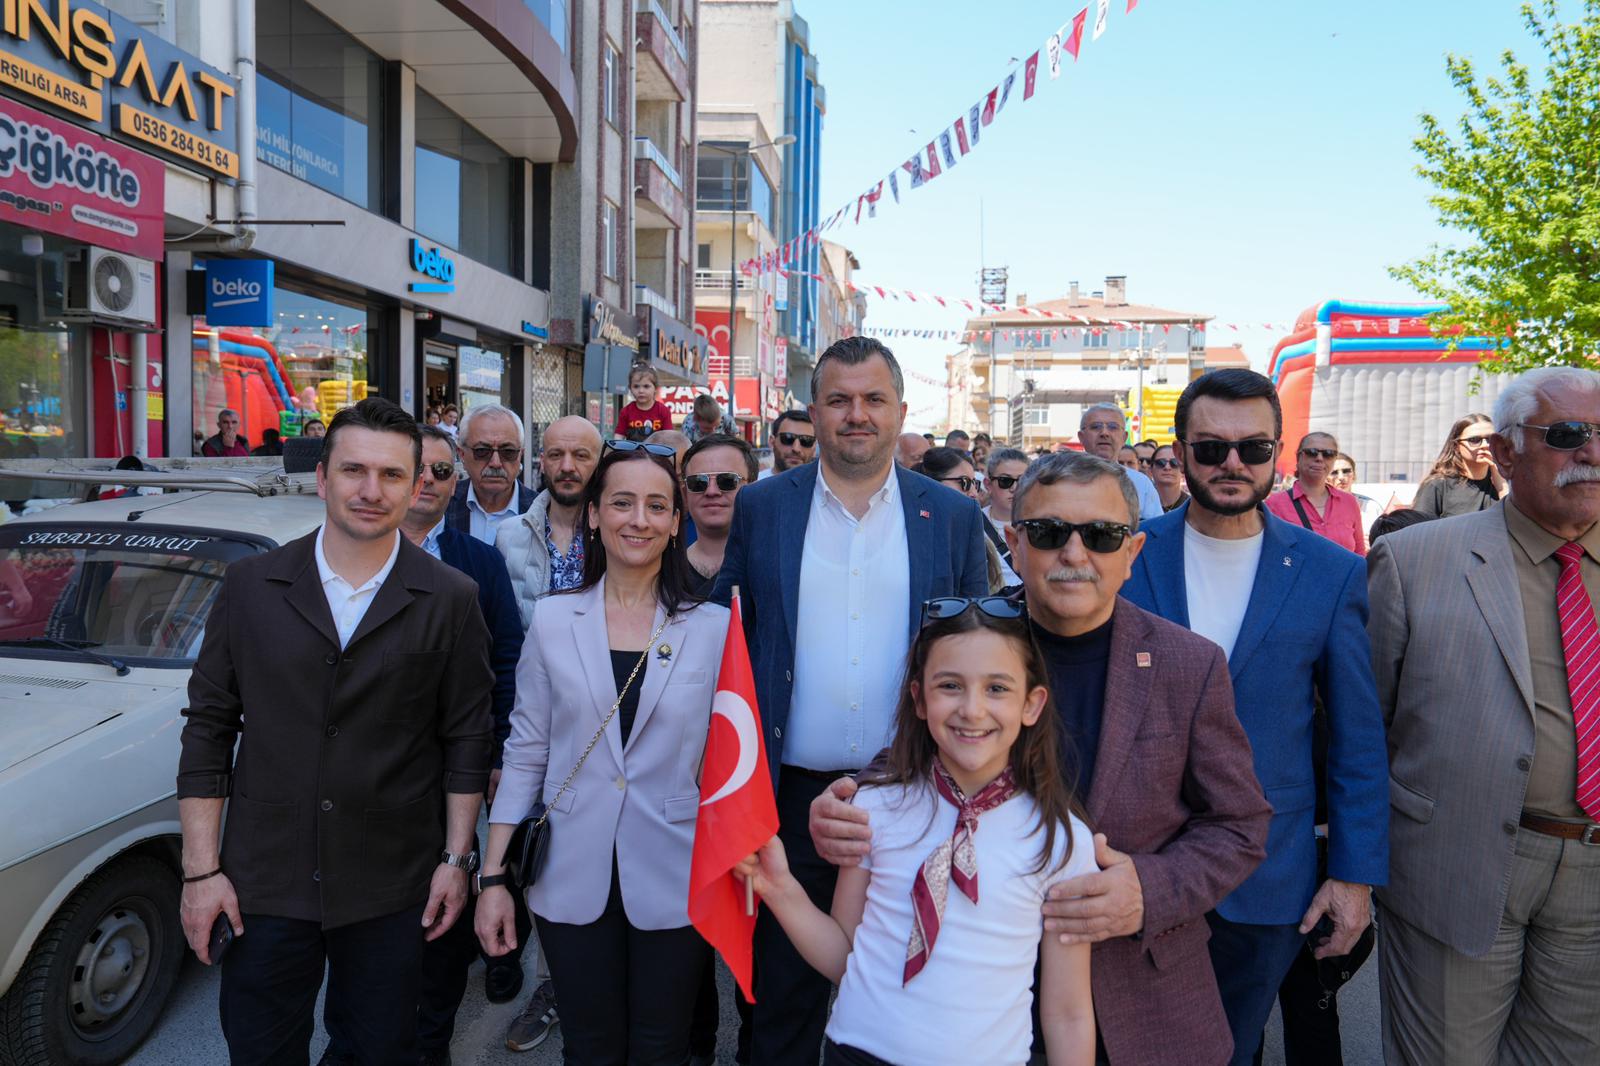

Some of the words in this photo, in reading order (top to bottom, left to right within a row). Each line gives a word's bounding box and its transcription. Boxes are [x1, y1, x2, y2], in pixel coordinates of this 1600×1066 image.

[55, 83, 88, 109] ARSA
[133, 113, 167, 142] 0536
[171, 129, 194, 154] 284
[198, 142, 211, 162] 91
[215, 150, 229, 169] 64
[414, 239, 455, 283] beko
[212, 277, 261, 296] beko
[20, 532, 121, 546] SARAYLI
[123, 534, 210, 551] UMUT
